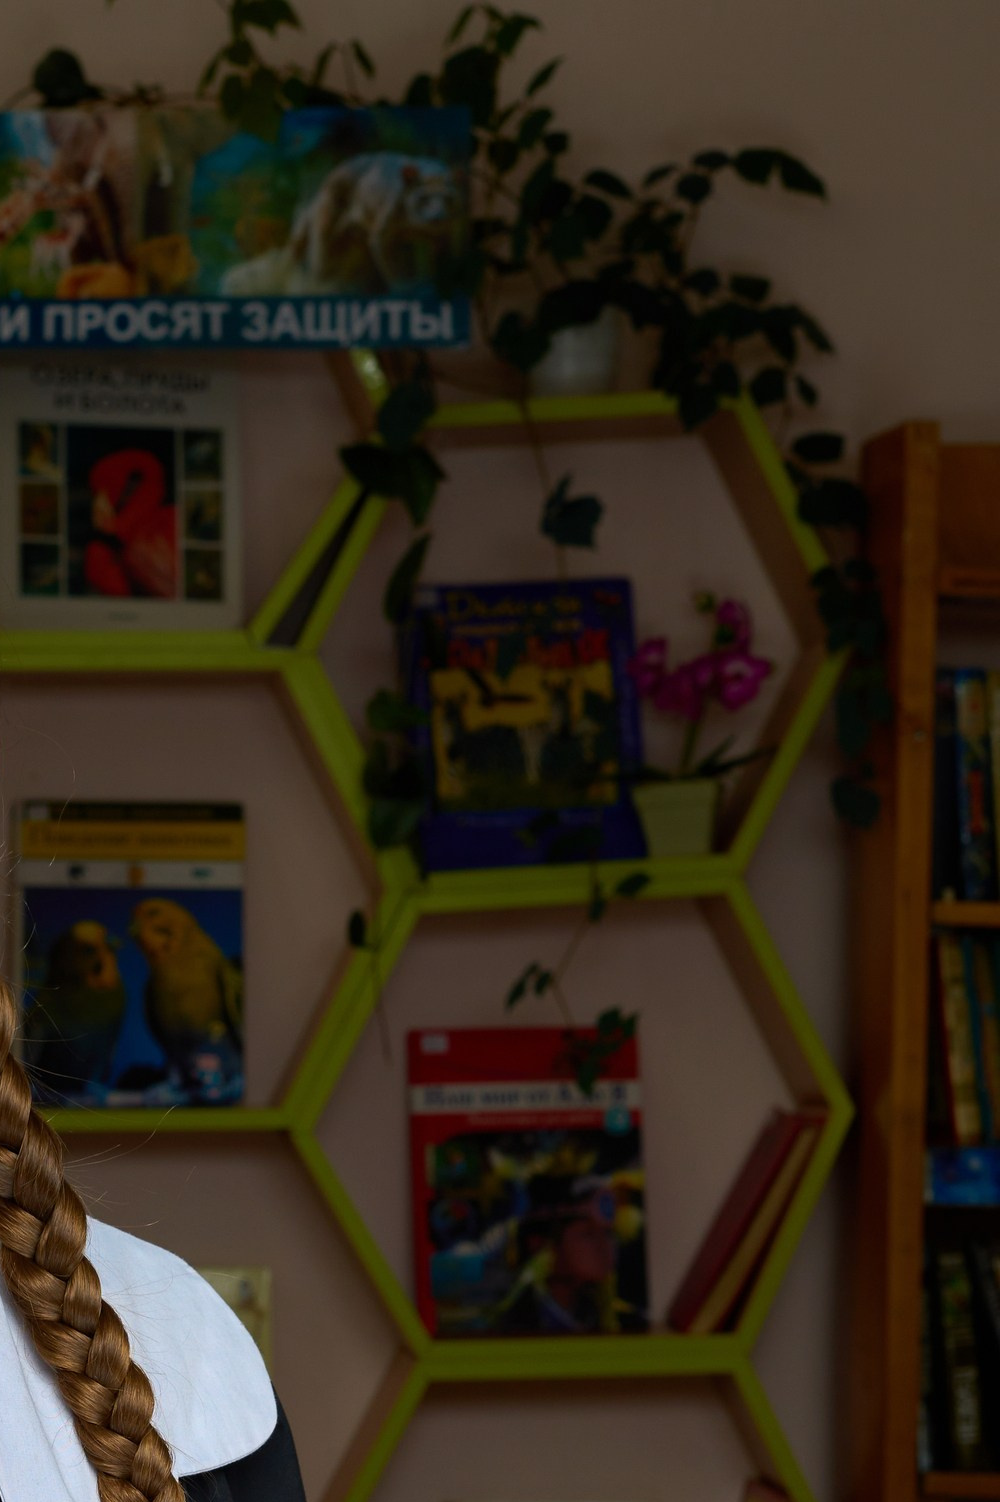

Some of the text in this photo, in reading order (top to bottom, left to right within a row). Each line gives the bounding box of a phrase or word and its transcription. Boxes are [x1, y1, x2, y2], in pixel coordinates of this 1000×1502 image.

[41, 300, 231, 344] ПРОСЯТ
[240, 299, 456, 347] ЗАЩИТЫ
[54, 392, 186, 414] И БОЛОТА
